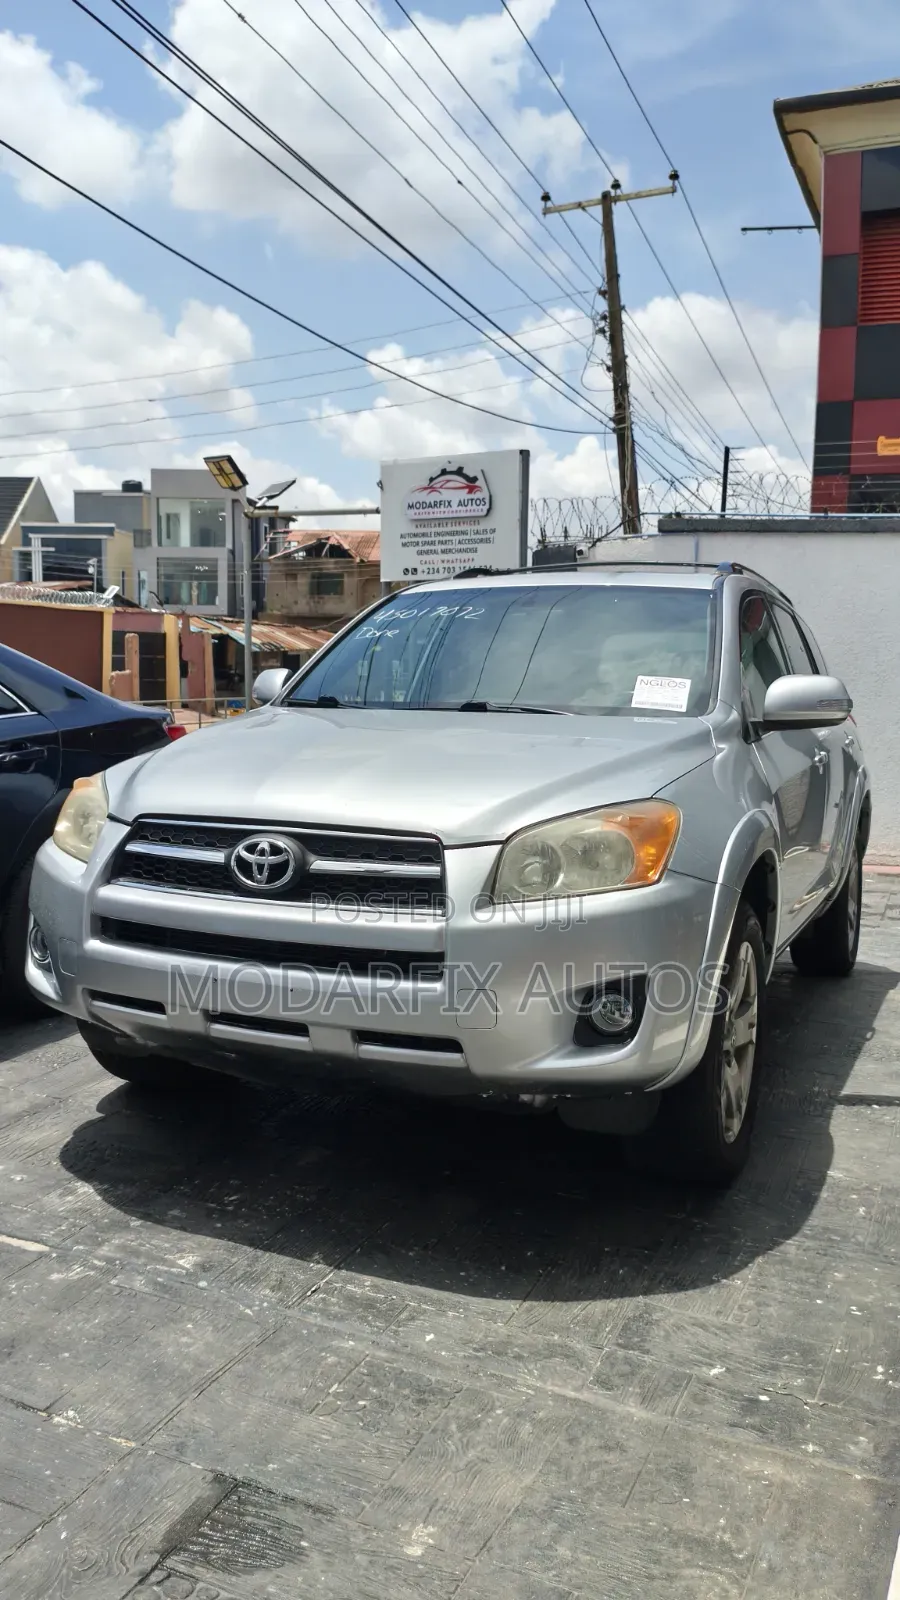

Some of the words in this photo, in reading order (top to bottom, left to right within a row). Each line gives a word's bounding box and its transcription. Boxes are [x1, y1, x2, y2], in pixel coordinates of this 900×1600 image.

[407, 500, 452, 510] MODARFIX
[457, 497, 487, 507] AUTOS
[400, 531, 432, 539] AUTOMOBILE
[433, 529, 468, 537] ENGINEERING
[472, 528, 488, 536] SALES
[401, 540, 420, 548] MOTOR
[420, 539, 436, 547] SPARE
[437, 538, 454, 546] PARTS
[457, 537, 492, 545] ACCESSORIES
[416, 548, 439, 556] GENERAL
[440, 547, 478, 555] MERCHANDISE
[420, 566, 440, 575] +234
[442, 565, 456, 574] 703
